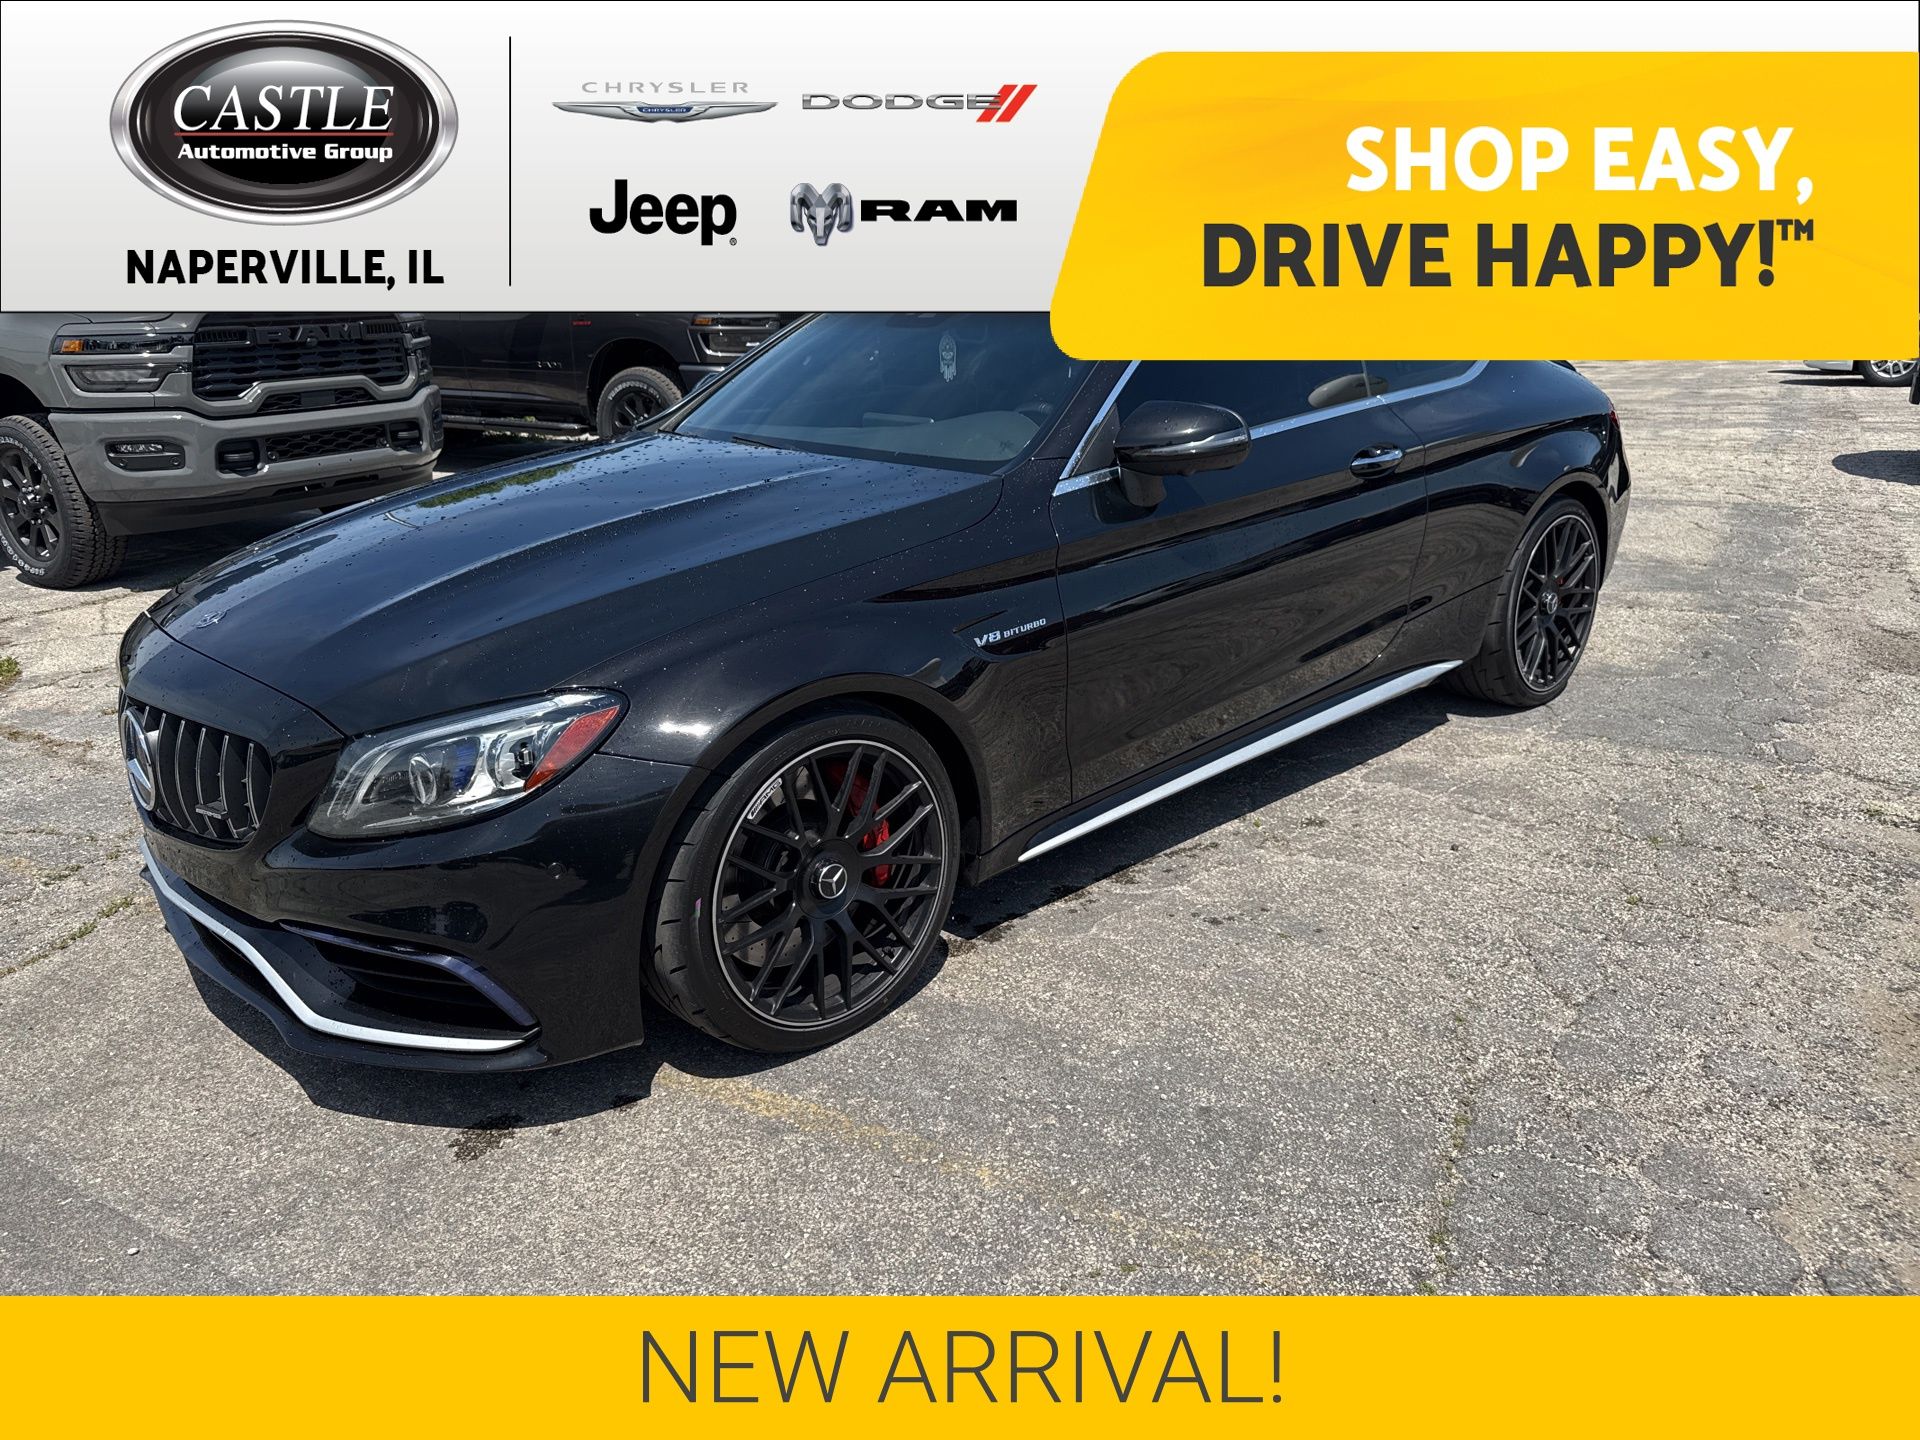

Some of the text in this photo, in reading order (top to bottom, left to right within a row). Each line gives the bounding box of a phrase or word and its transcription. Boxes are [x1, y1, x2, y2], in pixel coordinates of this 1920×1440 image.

[255, 321, 364, 344] RAM
[974, 618, 1047, 647] V8 BITURBO
